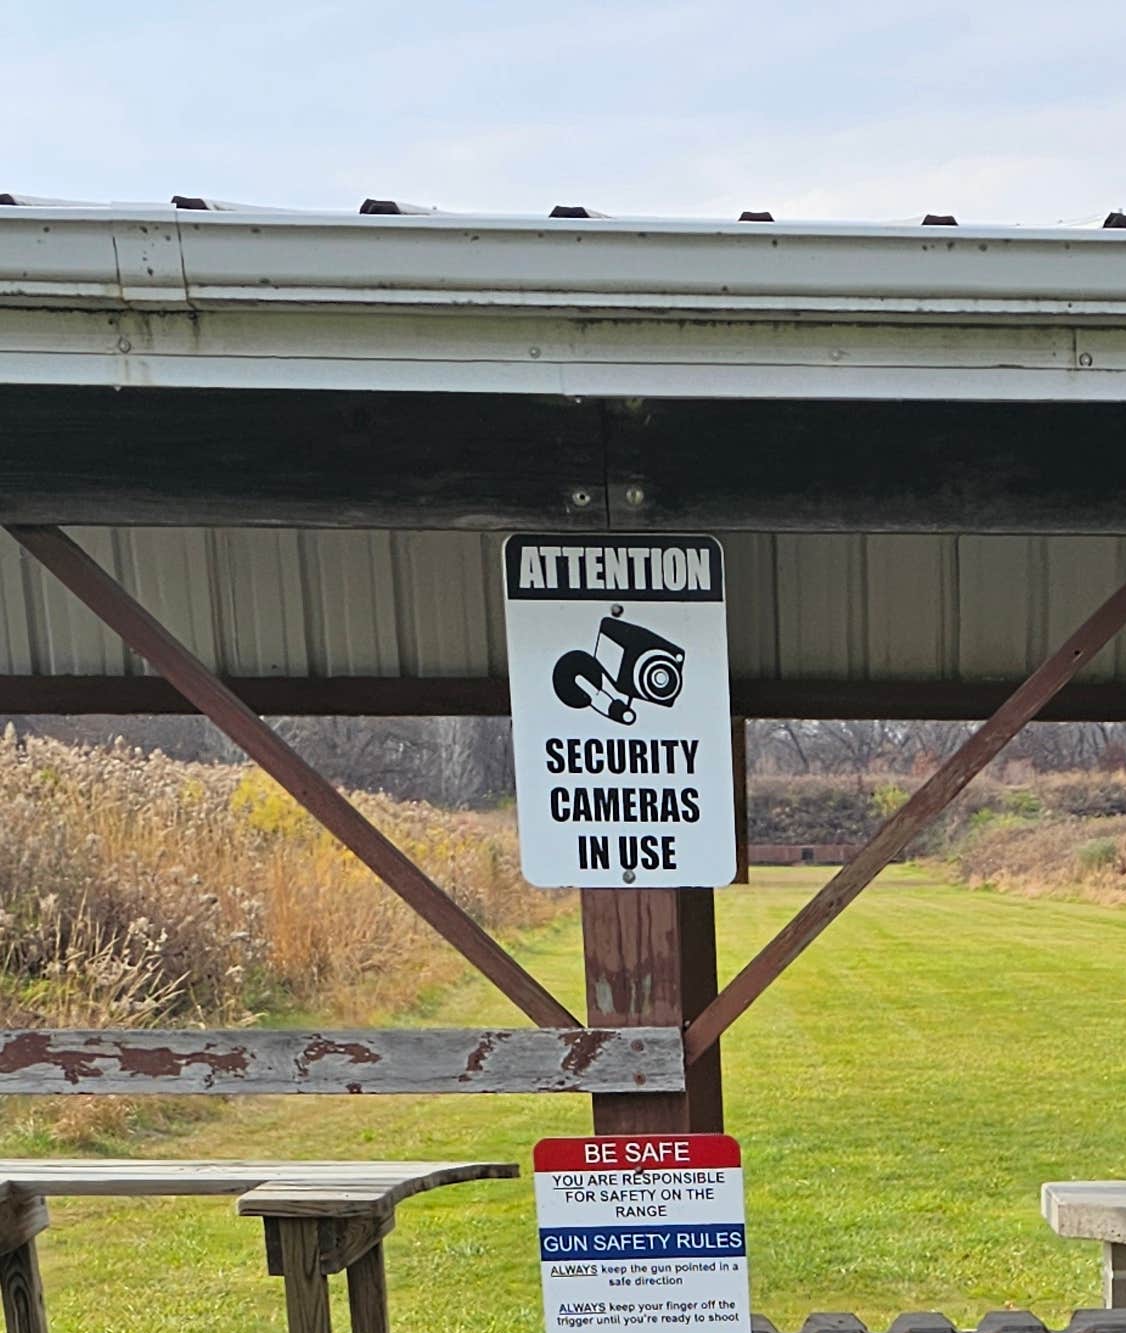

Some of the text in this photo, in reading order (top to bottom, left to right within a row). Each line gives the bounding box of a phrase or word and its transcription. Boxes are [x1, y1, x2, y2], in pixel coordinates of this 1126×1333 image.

[519, 546, 710, 591] ATTENTION
[546, 739, 699, 774] SECURITY
[551, 787, 699, 823] CAMERAS
[578, 836, 676, 870] IN USE
[585, 1142, 690, 1164] BE SAFE
[553, 1172, 725, 1188] YOU ARE RESPONSIBLE
[566, 1188, 714, 1202] FOR SAFETY ON THE
[616, 1205, 667, 1218] RANGE
[543, 1232, 742, 1252] GUN SAFETY RULES
[550, 1265, 598, 1276] ALWAYS
[602, 1265, 627, 1276] keep
[631, 1264, 648, 1273] the
[651, 1264, 672, 1275] gun
[675, 1263, 716, 1274] pointed
[719, 1263, 729, 1271] in
[609, 1276, 683, 1287] safe direction
[559, 1300, 735, 1314] ALWAYS keep your finger off the
[557, 1312, 739, 1327] trigger until you're ready to shoot
